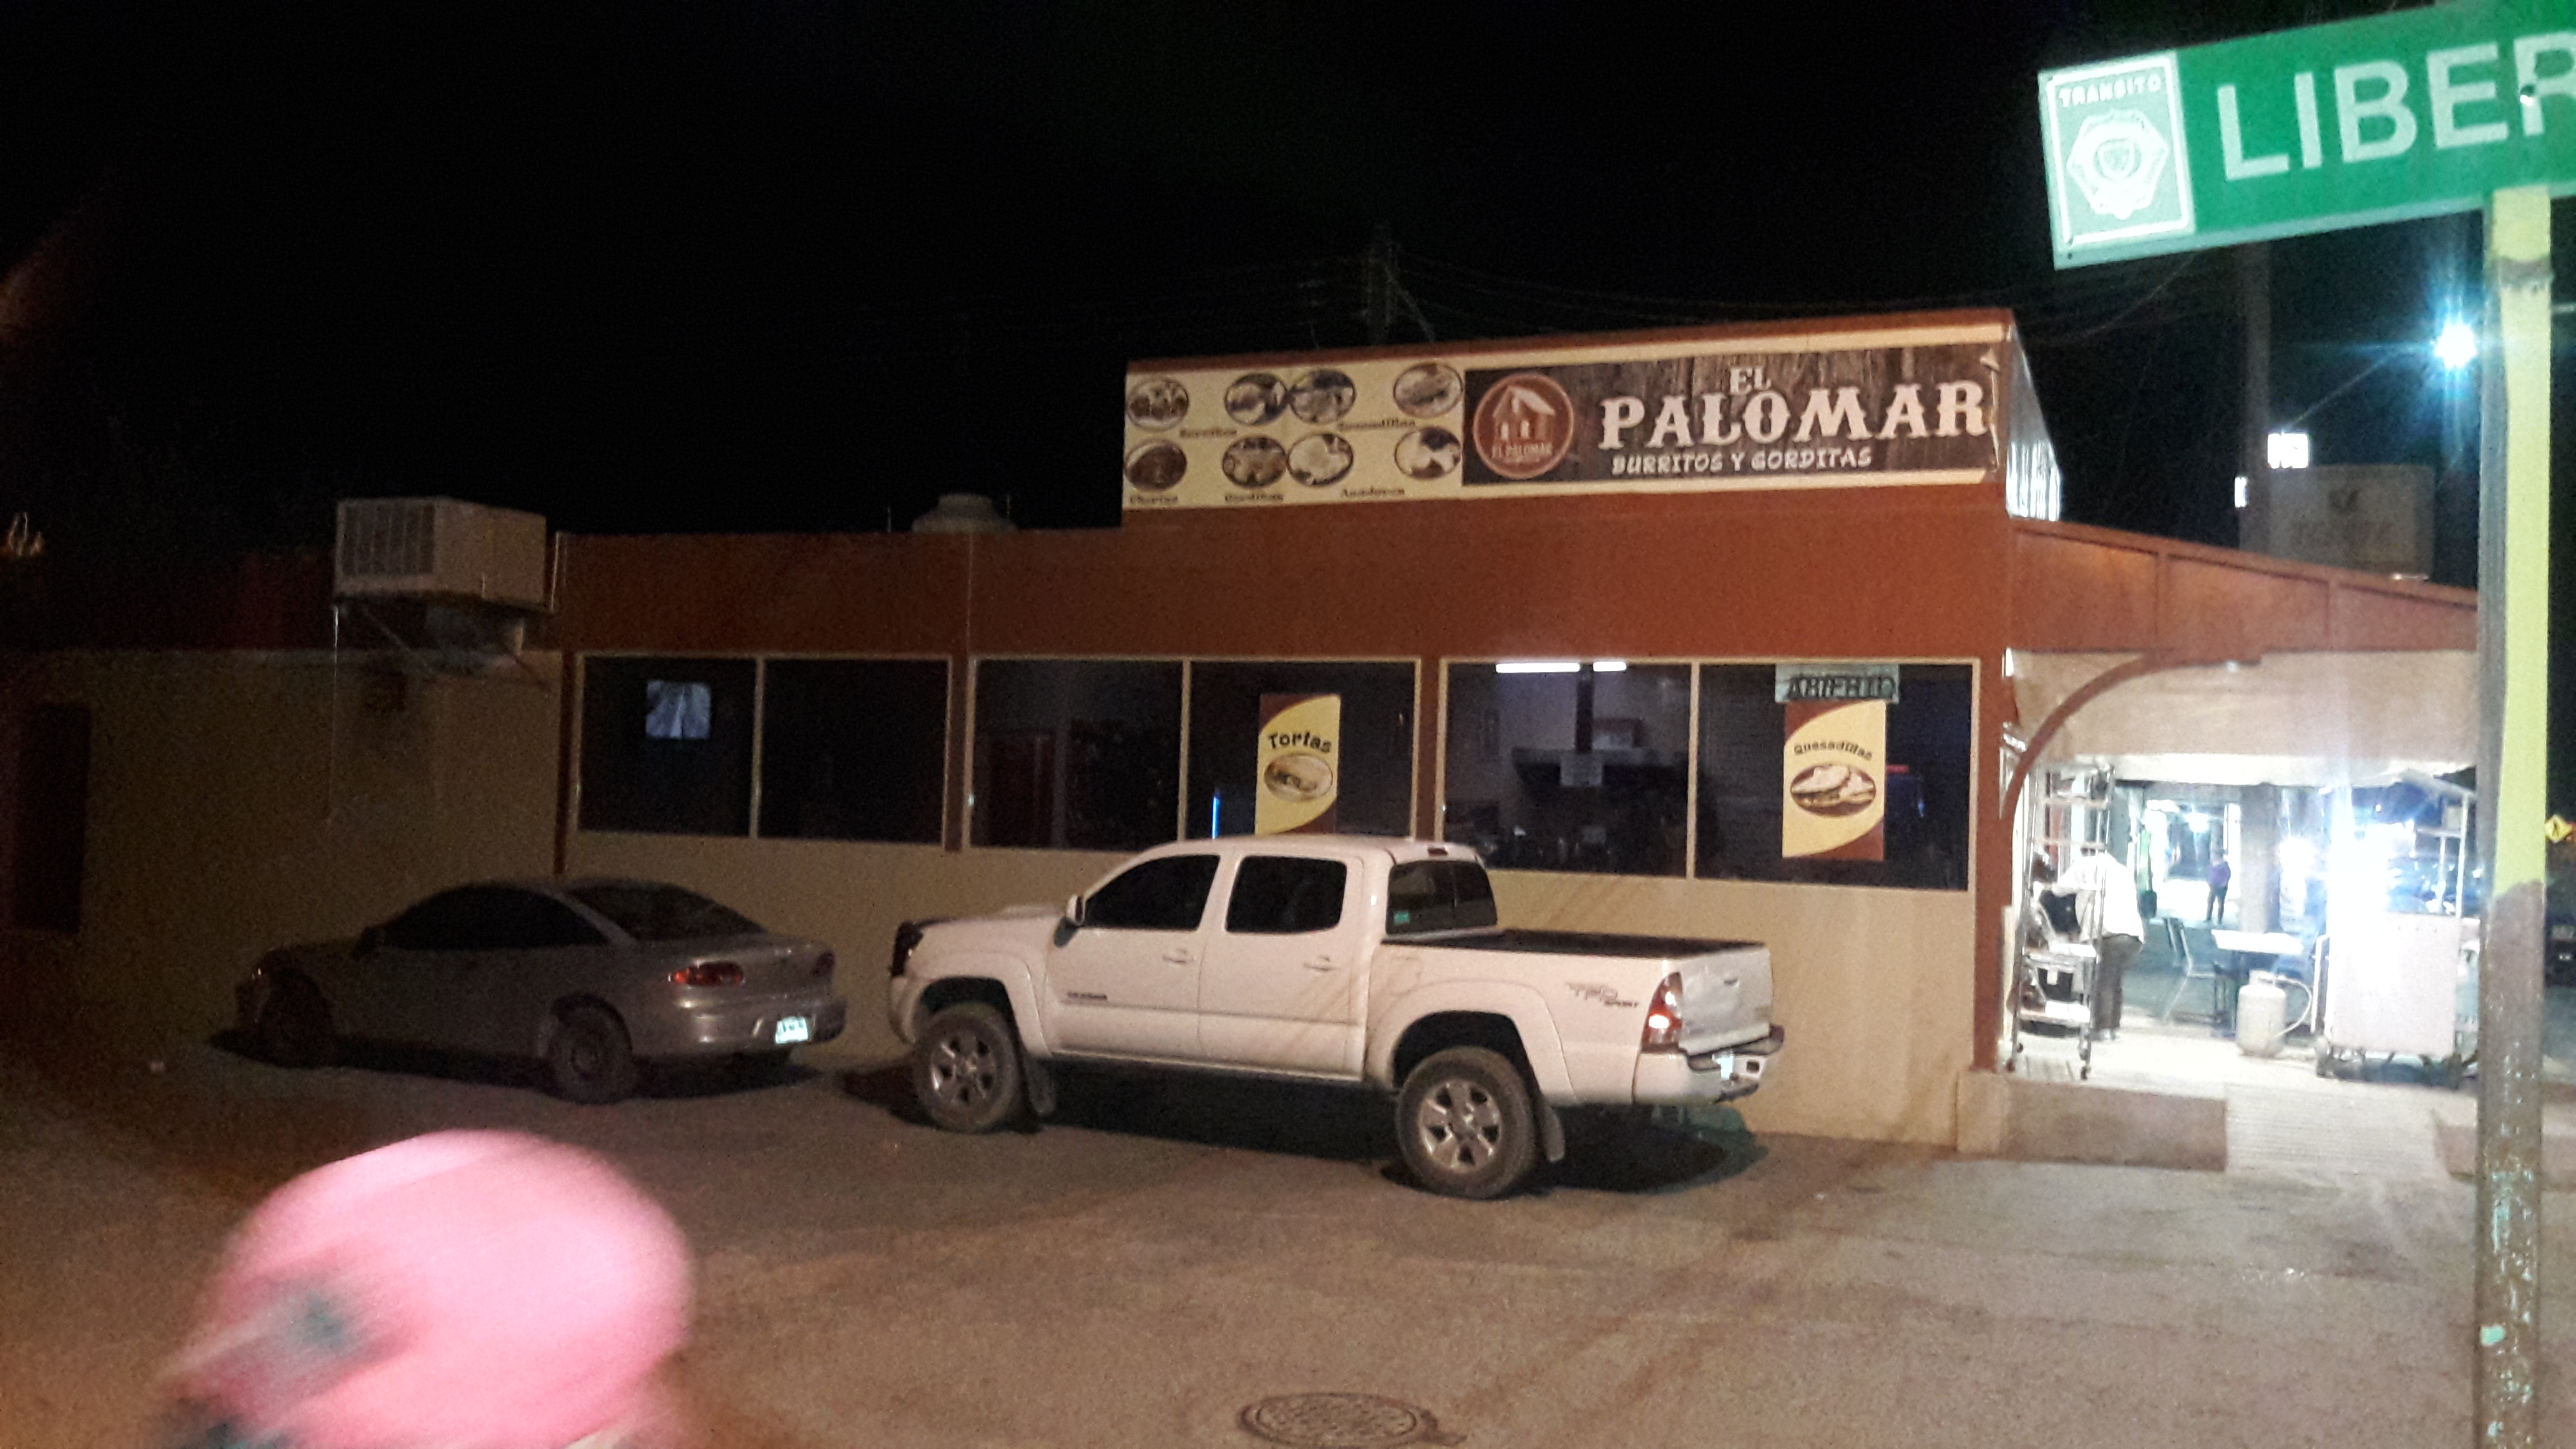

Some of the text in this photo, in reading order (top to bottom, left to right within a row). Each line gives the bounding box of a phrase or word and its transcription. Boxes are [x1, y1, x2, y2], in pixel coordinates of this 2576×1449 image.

[2059, 73, 2162, 108] TRANSITO
[2217, 32, 2576, 181] LIBER
[1730, 366, 1772, 396] EL
[1598, 379, 1988, 451] PALOMAR
[1611, 446, 1872, 475] BURRITOS Y GORDITAS
[1268, 731, 1332, 753] Tortas
[1793, 741, 1873, 761] Quesadillas
